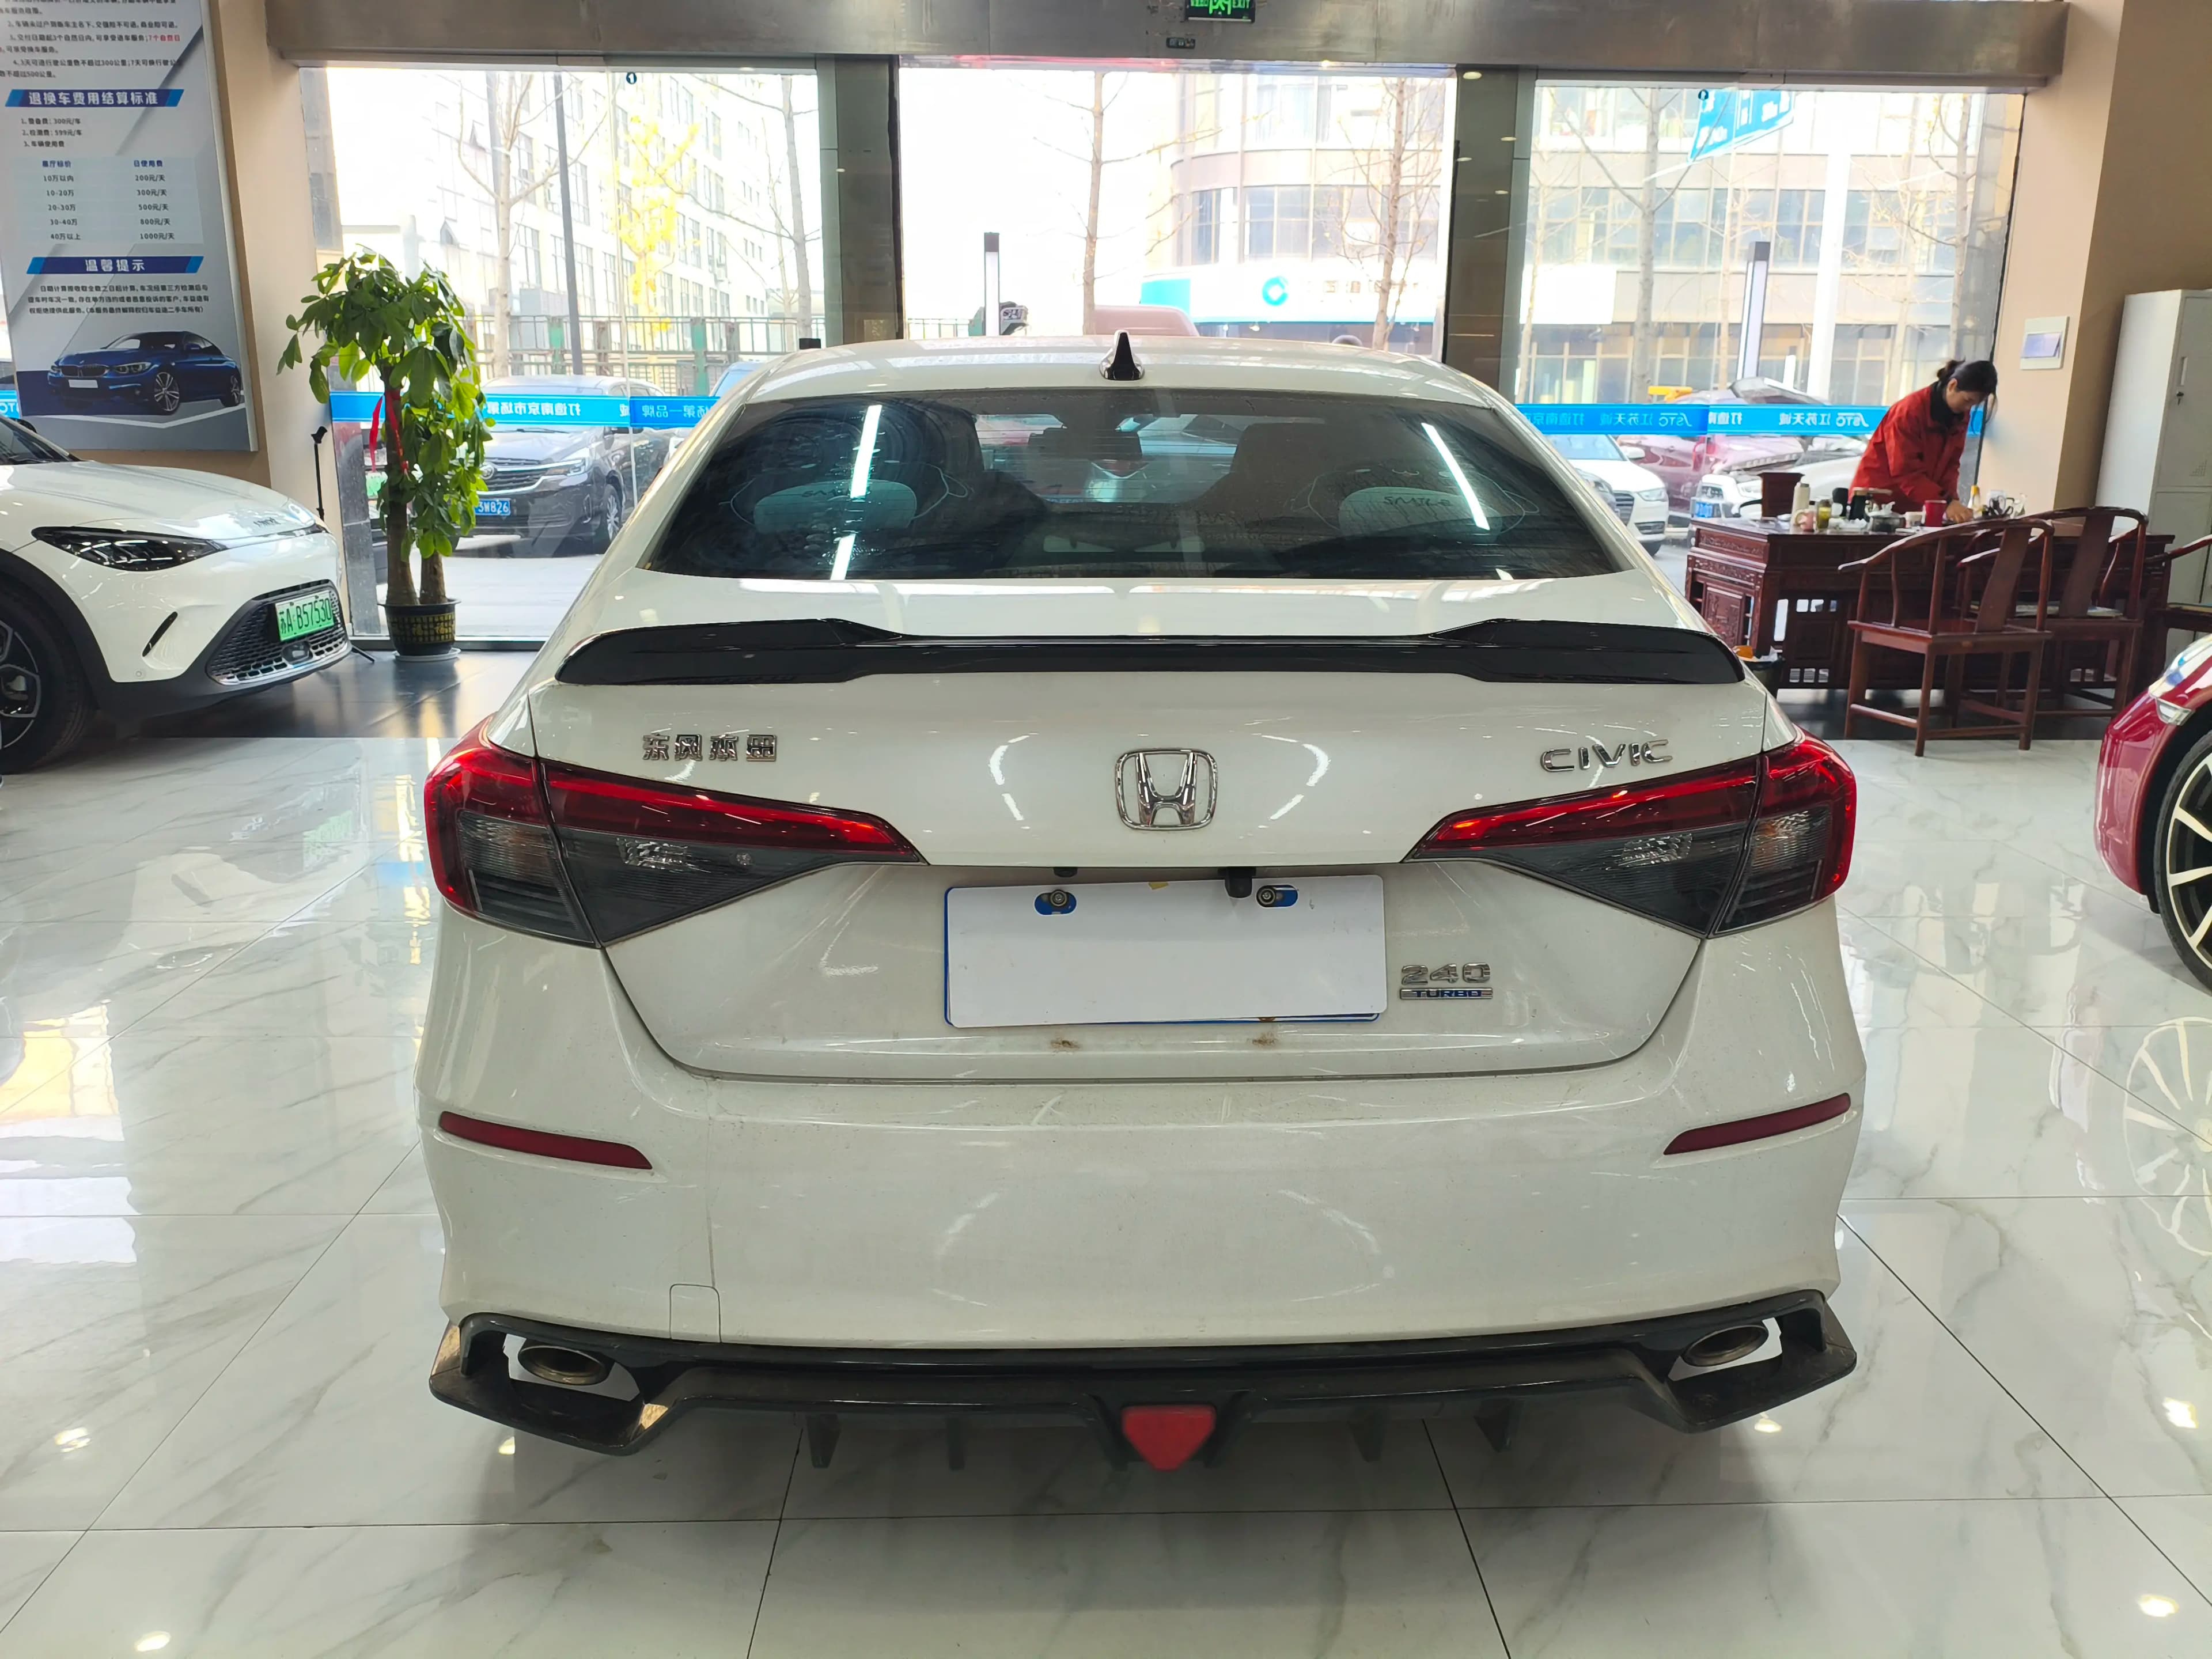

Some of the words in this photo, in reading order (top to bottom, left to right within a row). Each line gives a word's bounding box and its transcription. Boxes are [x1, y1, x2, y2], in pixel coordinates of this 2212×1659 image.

[29, 92, 158, 105] 退换车费用结算标准
[85, 259, 145, 272] 温馨提示
[642, 733, 777, 762] 东风本田
[1540, 738, 1673, 772] CIVIC
[1401, 962, 1491, 986] 240
[1412, 990, 1482, 998] TURBO
